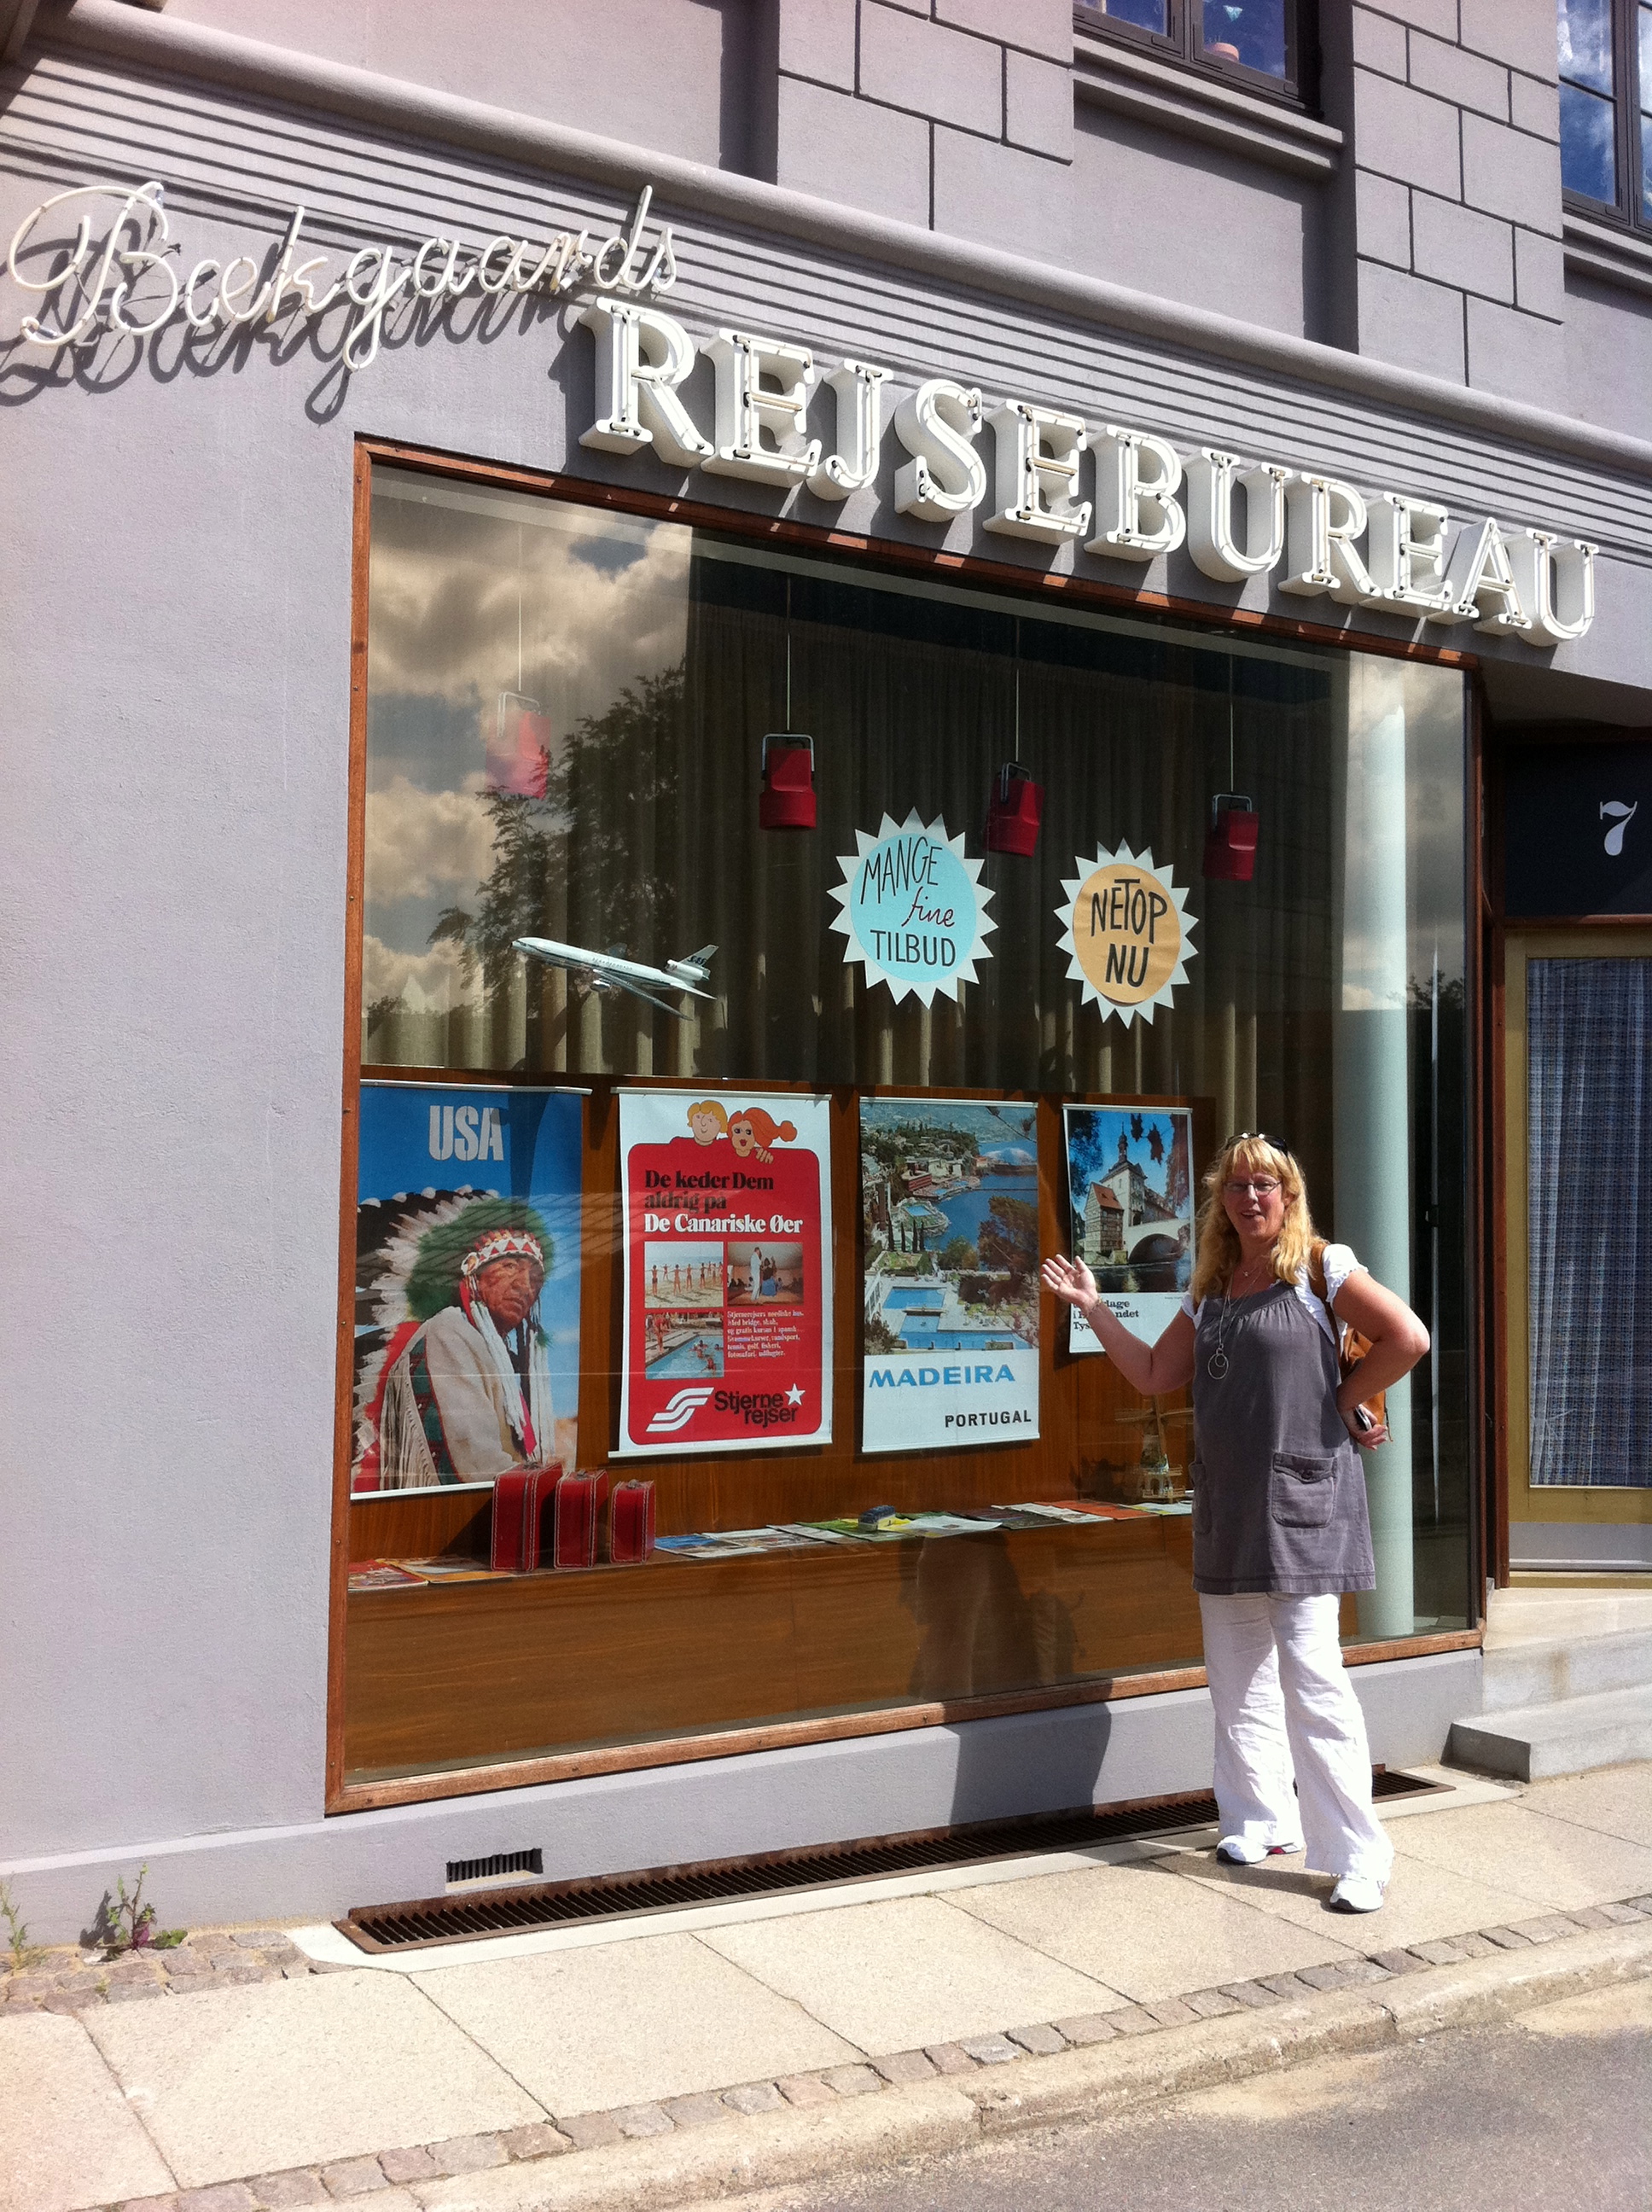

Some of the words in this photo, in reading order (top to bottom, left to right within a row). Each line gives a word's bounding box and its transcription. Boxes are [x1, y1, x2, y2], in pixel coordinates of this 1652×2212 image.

[579, 296, 1599, 647] REJSEBUREAU
[1600, 800, 1637, 856] 7
[860, 836, 943, 905] MANGE
[902, 886, 955, 928] fine
[1091, 878, 1167, 944] NETOP
[870, 929, 956, 968] TILBUD
[1105, 943, 1149, 987] NU
[429, 1105, 504, 1161] USA
[645, 1170, 672, 1189] De
[676, 1170, 730, 1189] keder
[732, 1172, 774, 1190] Dem
[644, 1190, 700, 1214] aldrig
[704, 1191, 727, 1214] på
[644, 1214, 670, 1232] De
[675, 1214, 766, 1233] Canariske
[770, 1214, 803, 1233] Øer
[869, 1364, 1015, 1388] MADEIRA
[714, 1390, 784, 1415] Stjerne
[744, 1406, 798, 1429] rejser
[945, 1410, 1032, 1428] PORTUGAL
